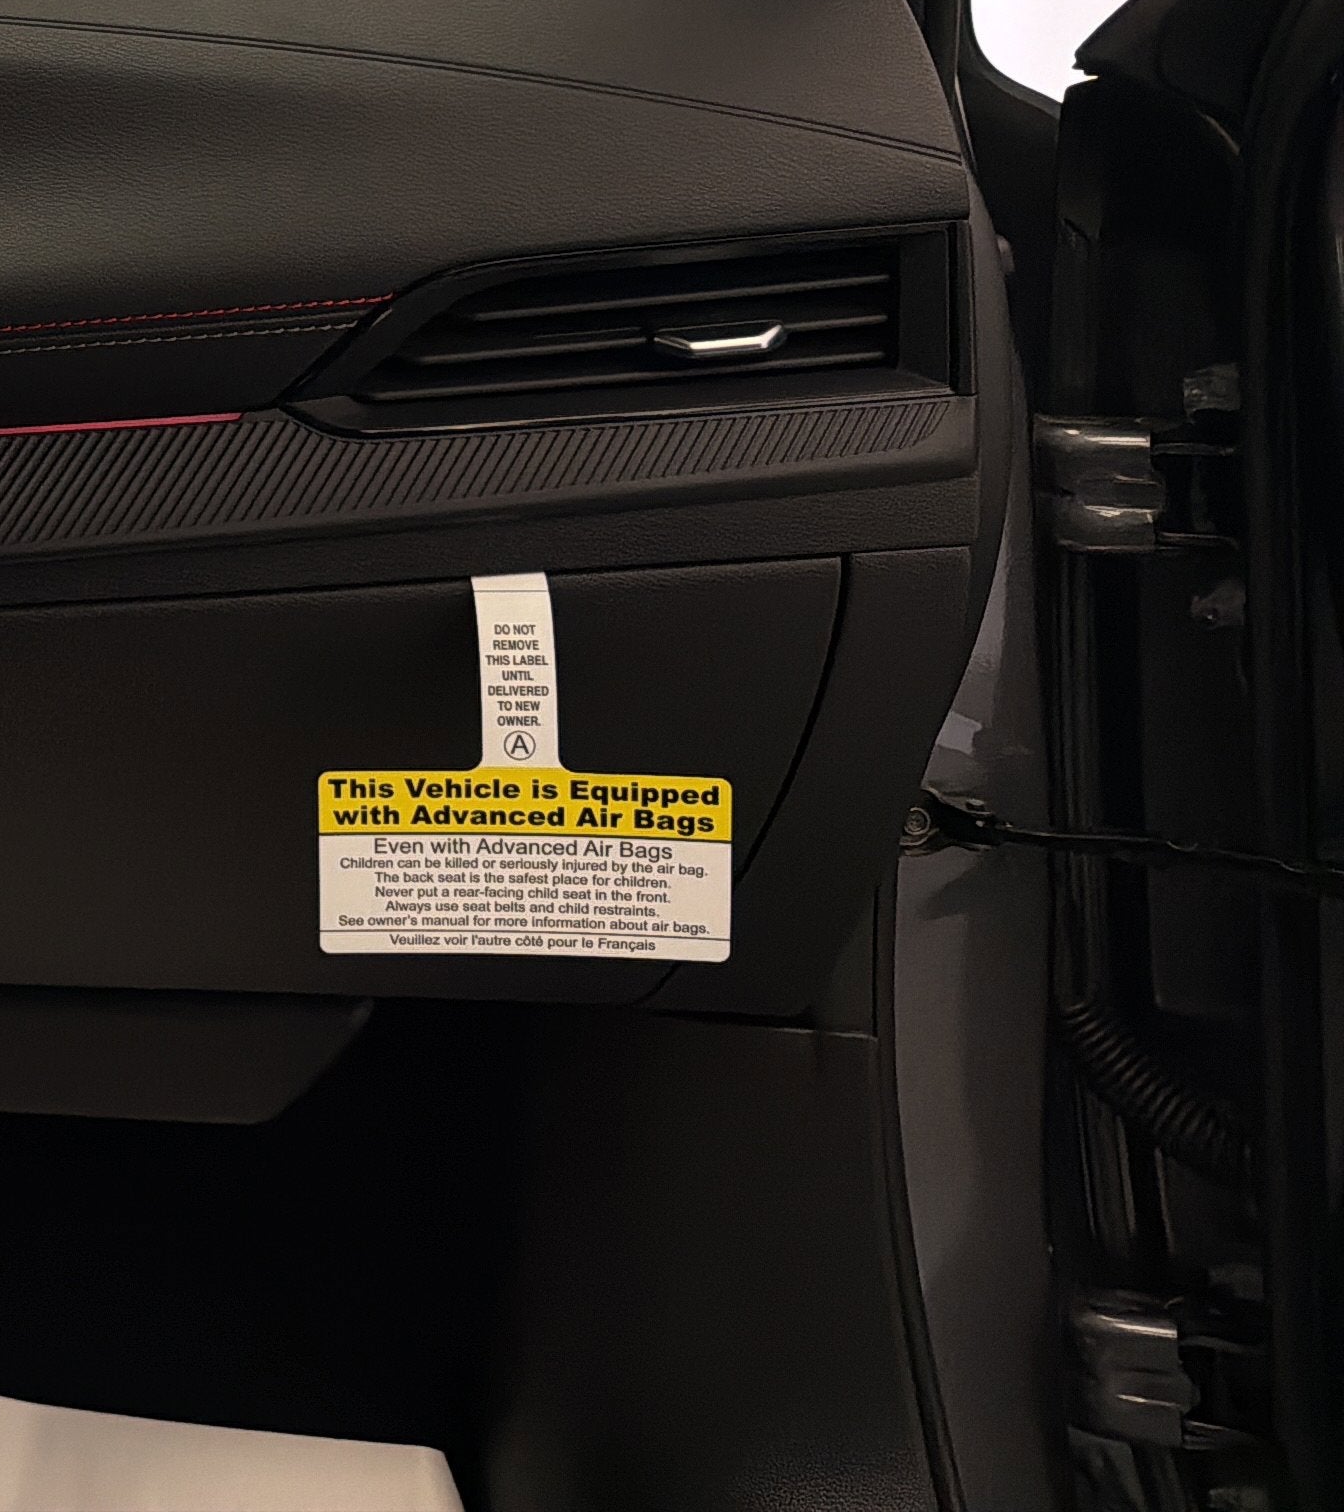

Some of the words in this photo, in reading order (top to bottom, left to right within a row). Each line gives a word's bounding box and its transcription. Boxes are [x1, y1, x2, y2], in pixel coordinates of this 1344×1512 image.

[494, 624, 509, 635] DO
[513, 624, 535, 635] NOT
[493, 639, 539, 651] REMOVE
[485, 654, 510, 666] THIS
[513, 655, 548, 666] LABEL
[502, 670, 533, 681] UNTIL
[487, 685, 549, 697] DELIVERED
[497, 701, 511, 711] TO
[515, 701, 539, 711] NEW
[497, 716, 540, 727] OWNER.
[327, 777, 394, 800] This
[404, 777, 520, 800] Vehicle
[531, 779, 558, 800] is
[569, 779, 720, 809] Equipped
[332, 804, 400, 827] with
[409, 803, 565, 828] Advanced
[574, 806, 624, 829] Air
[632, 808, 715, 838] Bags
[374, 837, 424, 854] Even
[430, 837, 471, 854] with
[475, 838, 578, 856] Advanced
[583, 840, 613, 857] Air
[619, 841, 673, 863] Bags
[340, 857, 393, 869] Children
[397, 860, 420, 869] can
[424, 857, 441, 869] be
[444, 857, 478, 869] killed
[482, 860, 496, 869] or
[499, 858, 558, 872] seriously
[562, 859, 607, 873] injured
[612, 861, 628, 875] by
[632, 862, 653, 873] the
[657, 863, 674, 874] air
[678, 864, 708, 878] bag.
[374, 872, 399, 883] The
[403, 872, 434, 883] back
[437, 873, 466, 883] seat
[470, 872, 480, 883] is
[484, 872, 504, 883] the
[508, 872, 548, 884] safest
[552, 873, 588, 887] place
[592, 874, 610, 886] for
[614, 876, 671, 889] children.
[374, 886, 413, 897] Never
[417, 887, 438, 900] put
[441, 888, 450, 897] a
[453, 886, 523, 900] rear-facing
[528, 888, 559, 899] child
[562, 889, 591, 900] seat
[595, 889, 607, 900] in
[611, 890, 632, 901] the
[636, 891, 671, 903] front.
[385, 900, 431, 914] Always
[435, 902, 459, 911] use
[463, 901, 491, 912] seat
[494, 901, 526, 912] belts
[529, 902, 554, 913] and
[558, 903, 589, 914] child
[593, 905, 660, 918] restraints.
[338, 915, 364, 926] See
[367, 914, 418, 926] owner's
[422, 915, 469, 926] manual
[473, 916, 491, 926] for
[494, 917, 528, 927] more
[531, 916, 606, 929] information
[609, 919, 648, 931] about
[651, 920, 669, 932] air
[673, 921, 710, 935] bags.
[389, 934, 440, 945] Veuillez
[444, 934, 469, 945] voir
[472, 935, 511, 946] l'autre
[515, 936, 543, 947] côté
[547, 938, 578, 950] pour
[582, 937, 593, 949] le
[598, 938, 656, 952] Français
